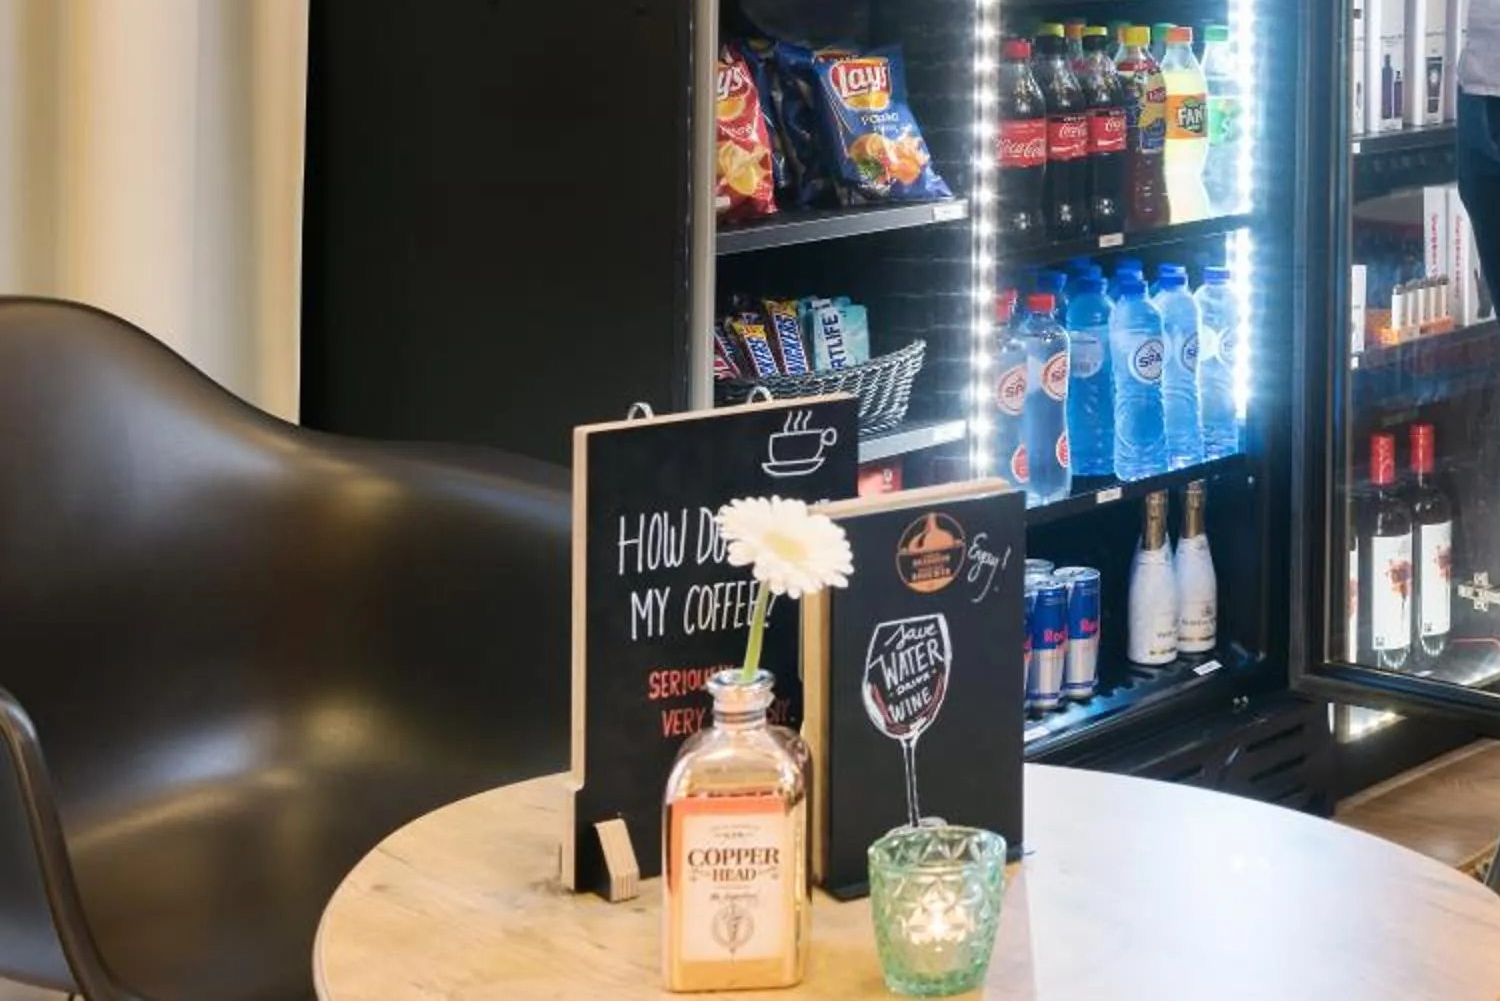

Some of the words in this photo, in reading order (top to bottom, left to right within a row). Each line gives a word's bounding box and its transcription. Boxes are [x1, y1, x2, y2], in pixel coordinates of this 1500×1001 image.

[839, 63, 888, 98] Lay's
[1177, 106, 1207, 127] FAN
[822, 314, 847, 372] RTLIFE
[618, 507, 688, 576] HOW
[631, 586, 671, 642] MY
[648, 664, 734, 699] SERIOU
[869, 638, 946, 691] WATER
[889, 686, 932, 723] WINE
[661, 707, 706, 739] VERY
[687, 846, 780, 868] COPPER
[712, 867, 758, 883] HEAD
